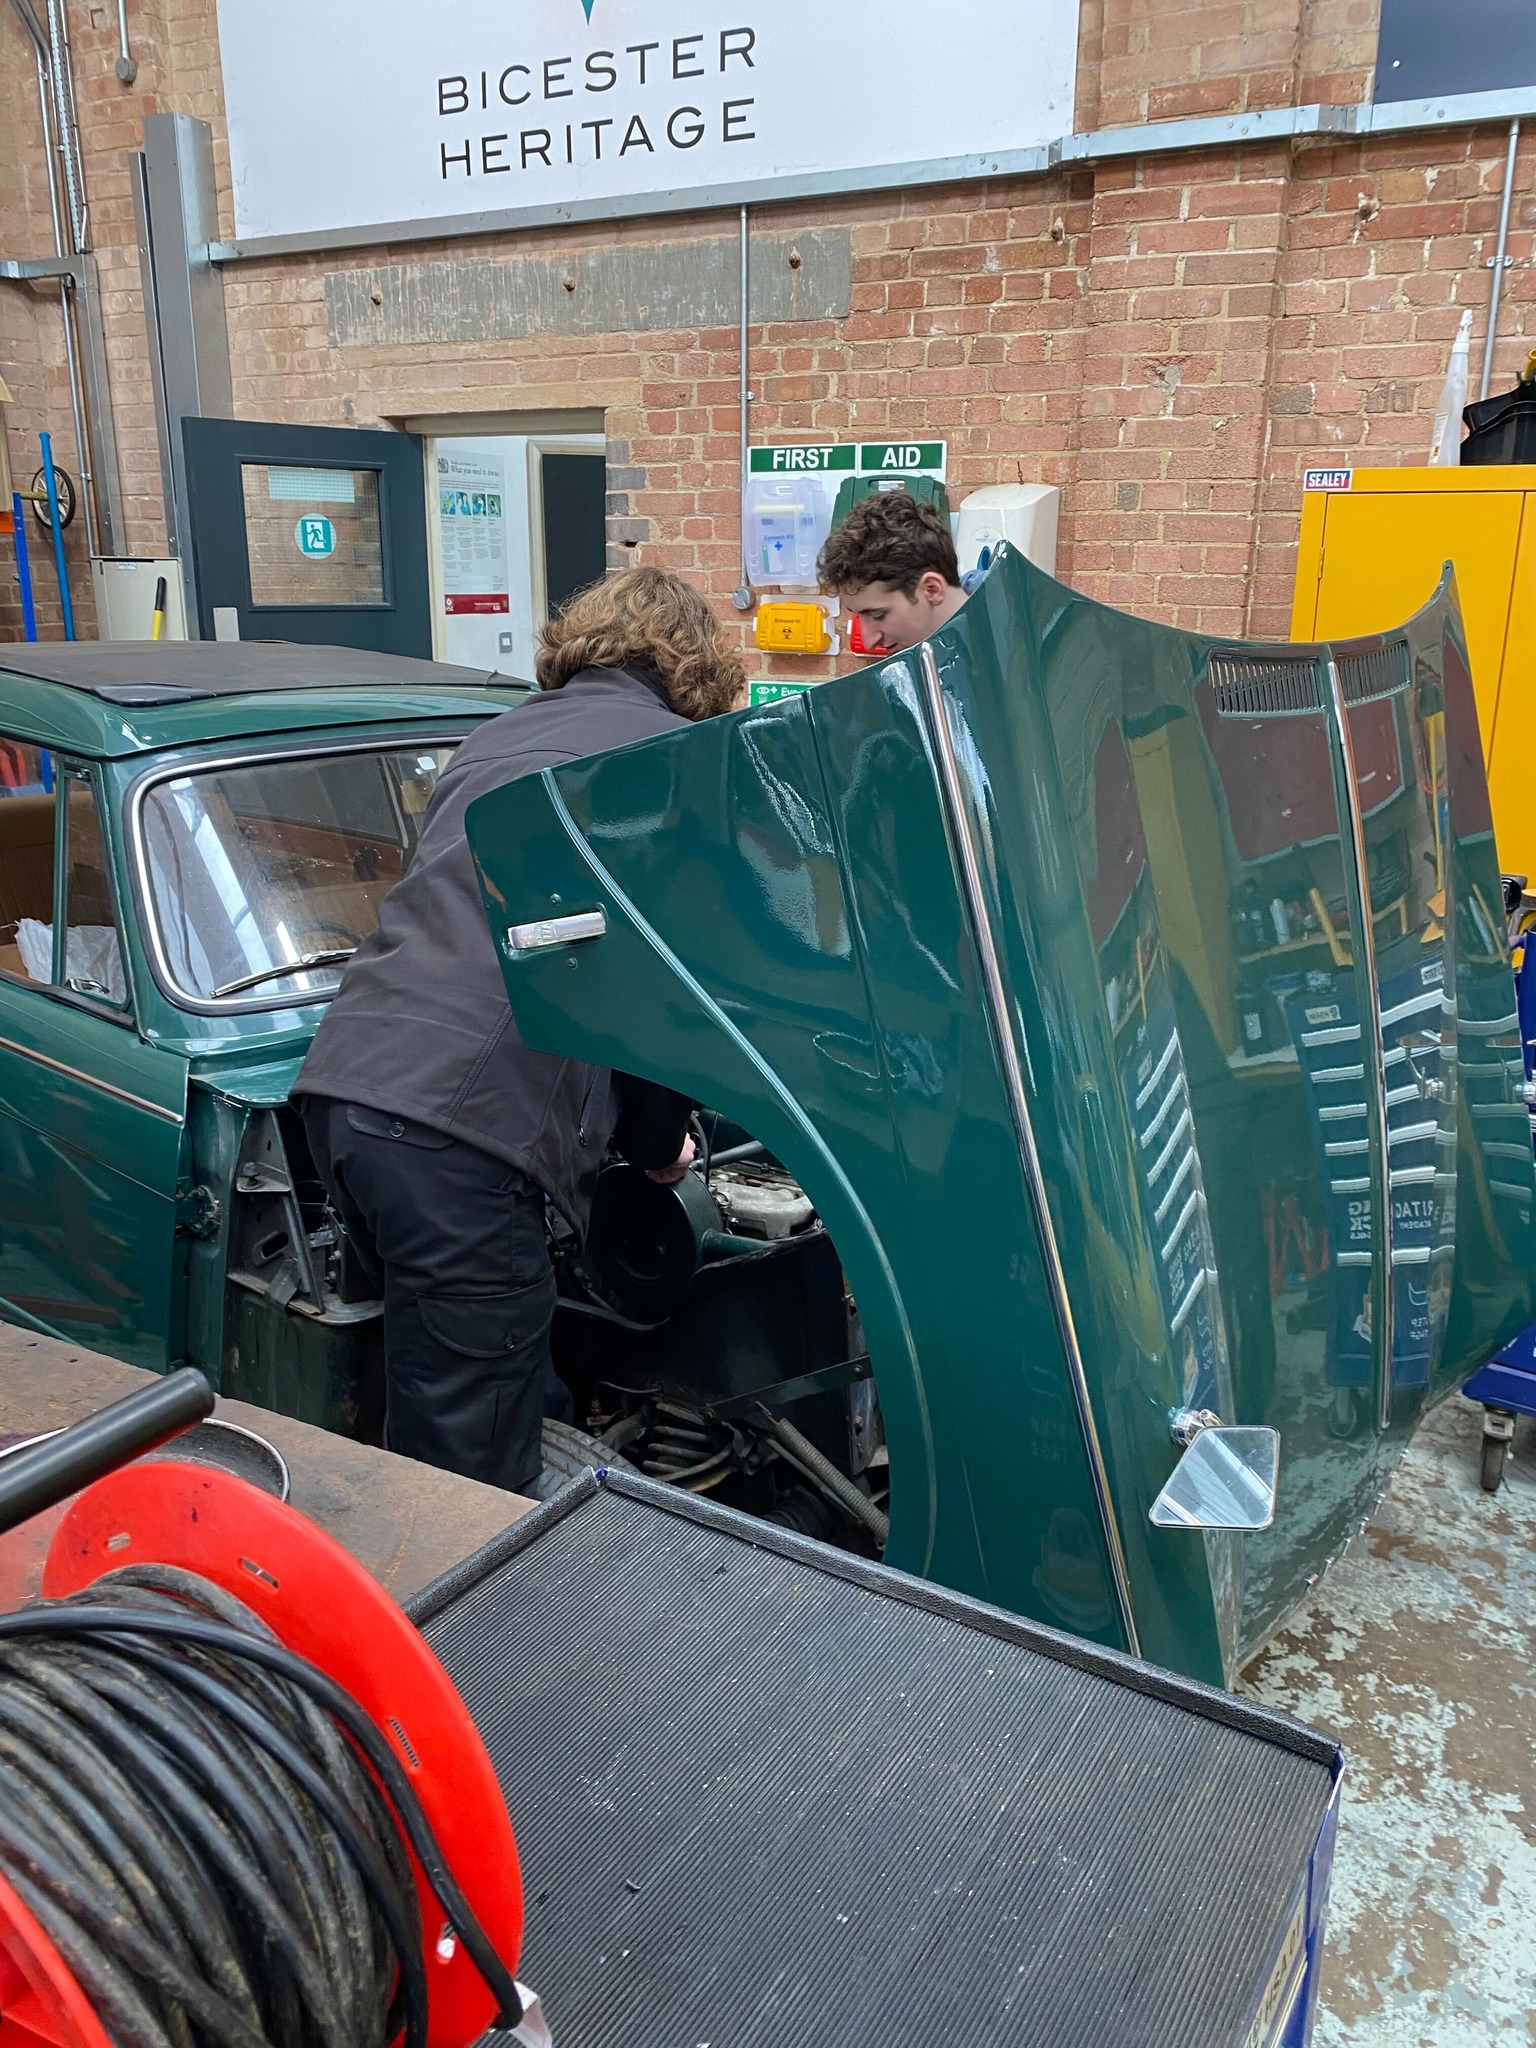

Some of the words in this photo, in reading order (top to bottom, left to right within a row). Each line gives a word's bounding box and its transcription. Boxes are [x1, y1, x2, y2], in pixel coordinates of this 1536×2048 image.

[438, 27, 756, 116] BICESTER
[440, 97, 756, 180] HERITAGE
[772, 447, 834, 470] FIRST
[881, 446, 922, 468] AID
[463, 468, 472, 476] you
[1308, 473, 1347, 487] SEALEY
